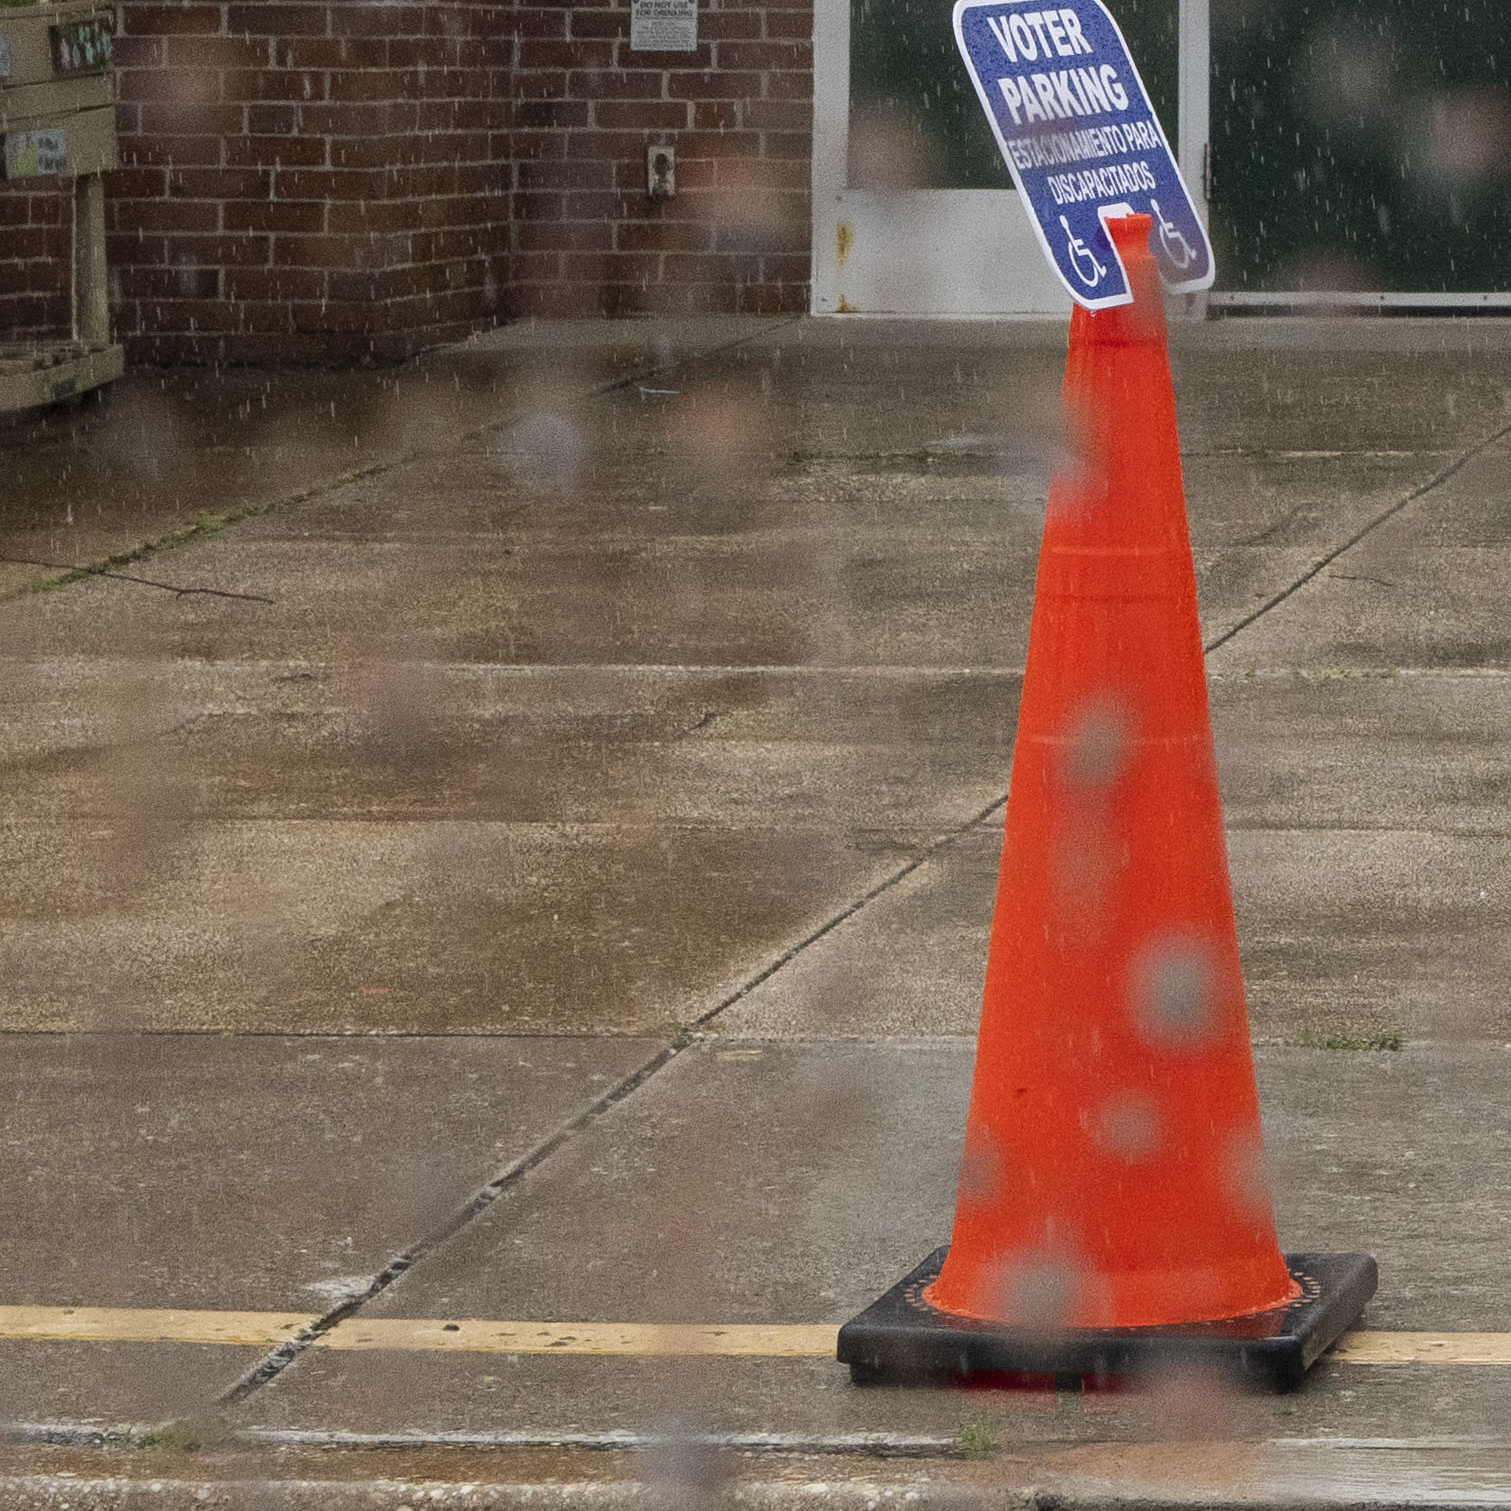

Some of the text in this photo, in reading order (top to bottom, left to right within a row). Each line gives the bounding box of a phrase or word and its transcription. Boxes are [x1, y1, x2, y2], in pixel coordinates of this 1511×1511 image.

[987, 8, 1093, 63] VOTER
[998, 64, 1129, 126] PARKING
[1008, 120, 1162, 170] ESTACIONAMIENTO PARA
[1047, 160, 1156, 205] DISCAPACITADOS
